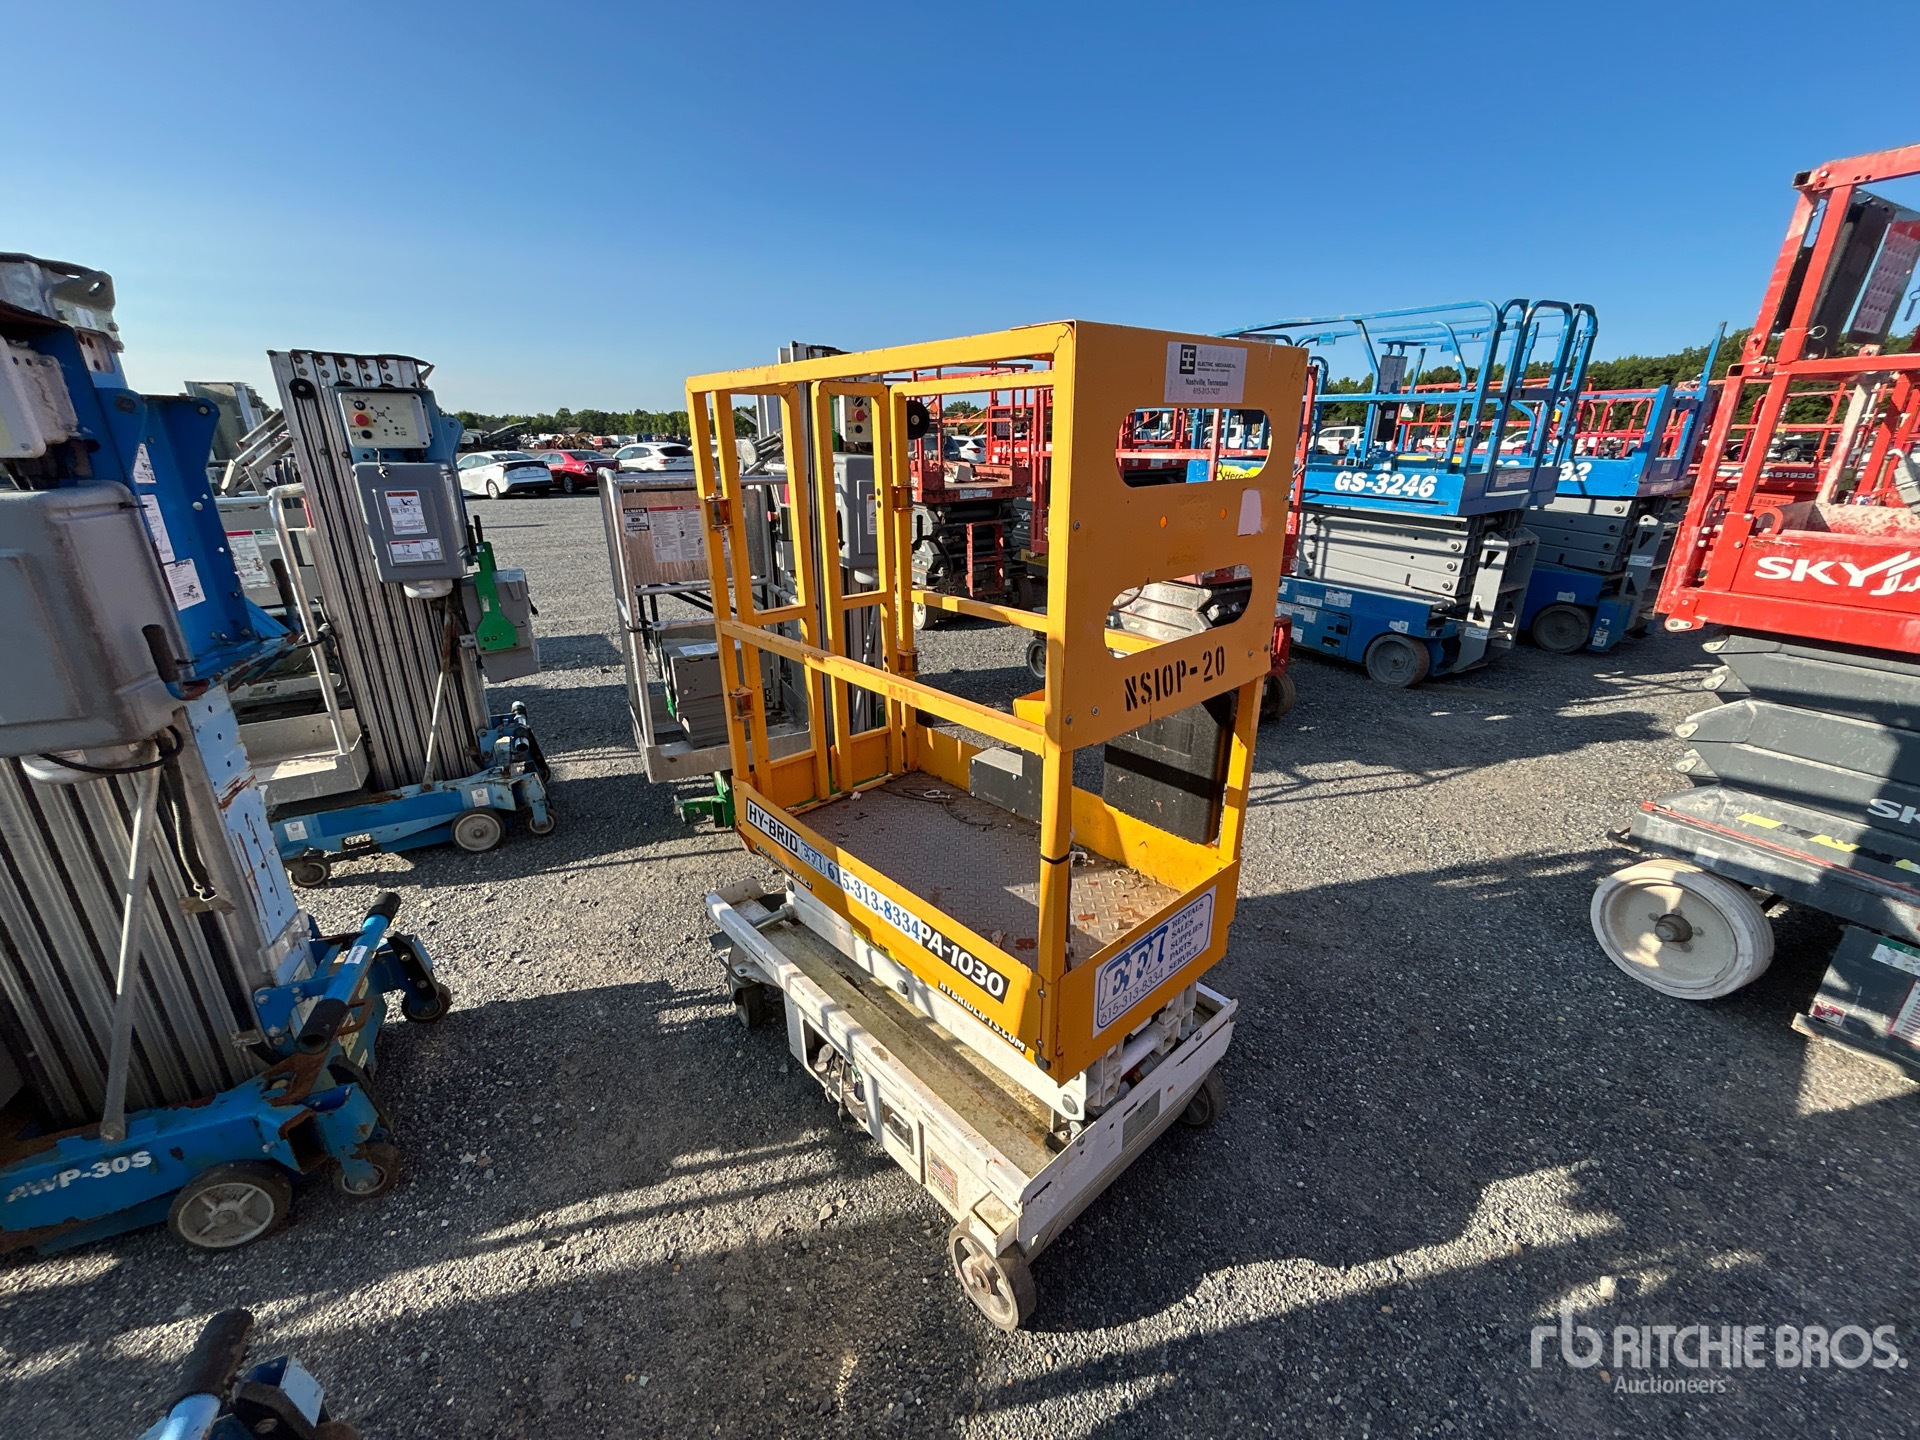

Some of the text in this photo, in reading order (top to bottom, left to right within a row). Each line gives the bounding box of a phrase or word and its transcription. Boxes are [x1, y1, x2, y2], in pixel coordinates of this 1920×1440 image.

[1207, 379, 1229, 387] Tennessee
[1334, 470, 1438, 498] GS-3246
[748, 802, 798, 853] HY-BRID
[827, 861, 920, 940] 615-313-8334
[1171, 900, 1204, 929] RENTALS
[1170, 920, 1204, 950] SUPPLIES
[1171, 917, 1195, 939] SALES
[920, 925, 1005, 997] PA-1030
[1168, 944, 1199, 972] SERVICE
[1169, 938, 1192, 961] PARTS
[1100, 967, 1164, 1024] 615-313-8334
